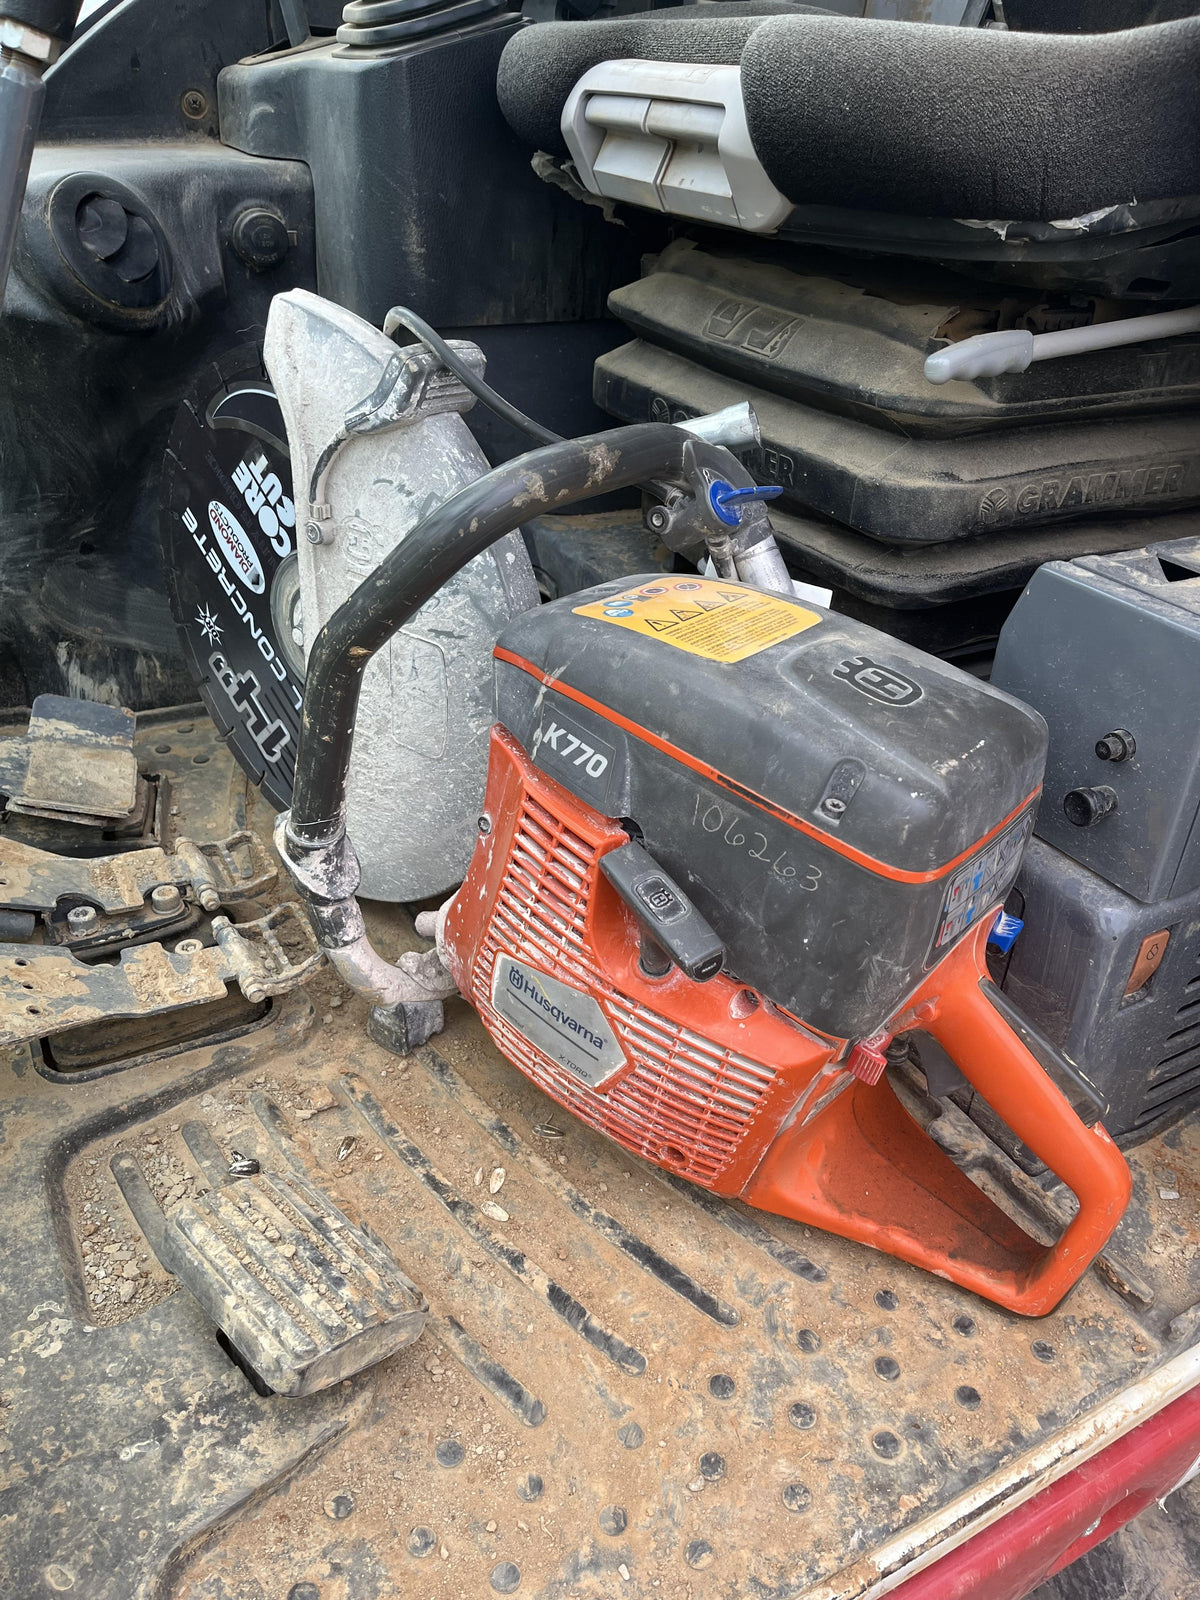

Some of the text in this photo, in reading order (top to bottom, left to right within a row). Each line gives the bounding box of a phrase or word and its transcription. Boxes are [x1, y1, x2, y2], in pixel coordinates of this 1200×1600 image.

[231, 460, 291, 558] CORE
[249, 454, 295, 528] CUT
[1017, 466, 1182, 513] GRAMMER
[209, 507, 249, 573] DIAMOND
[213, 501, 253, 569] PRODUCTS
[181, 507, 287, 682] CONCRETE
[198, 611, 220, 639] DRY
[542, 722, 609, 778] K770
[692, 793, 822, 892] 106263
[524, 980, 604, 1049] Husqvarna
